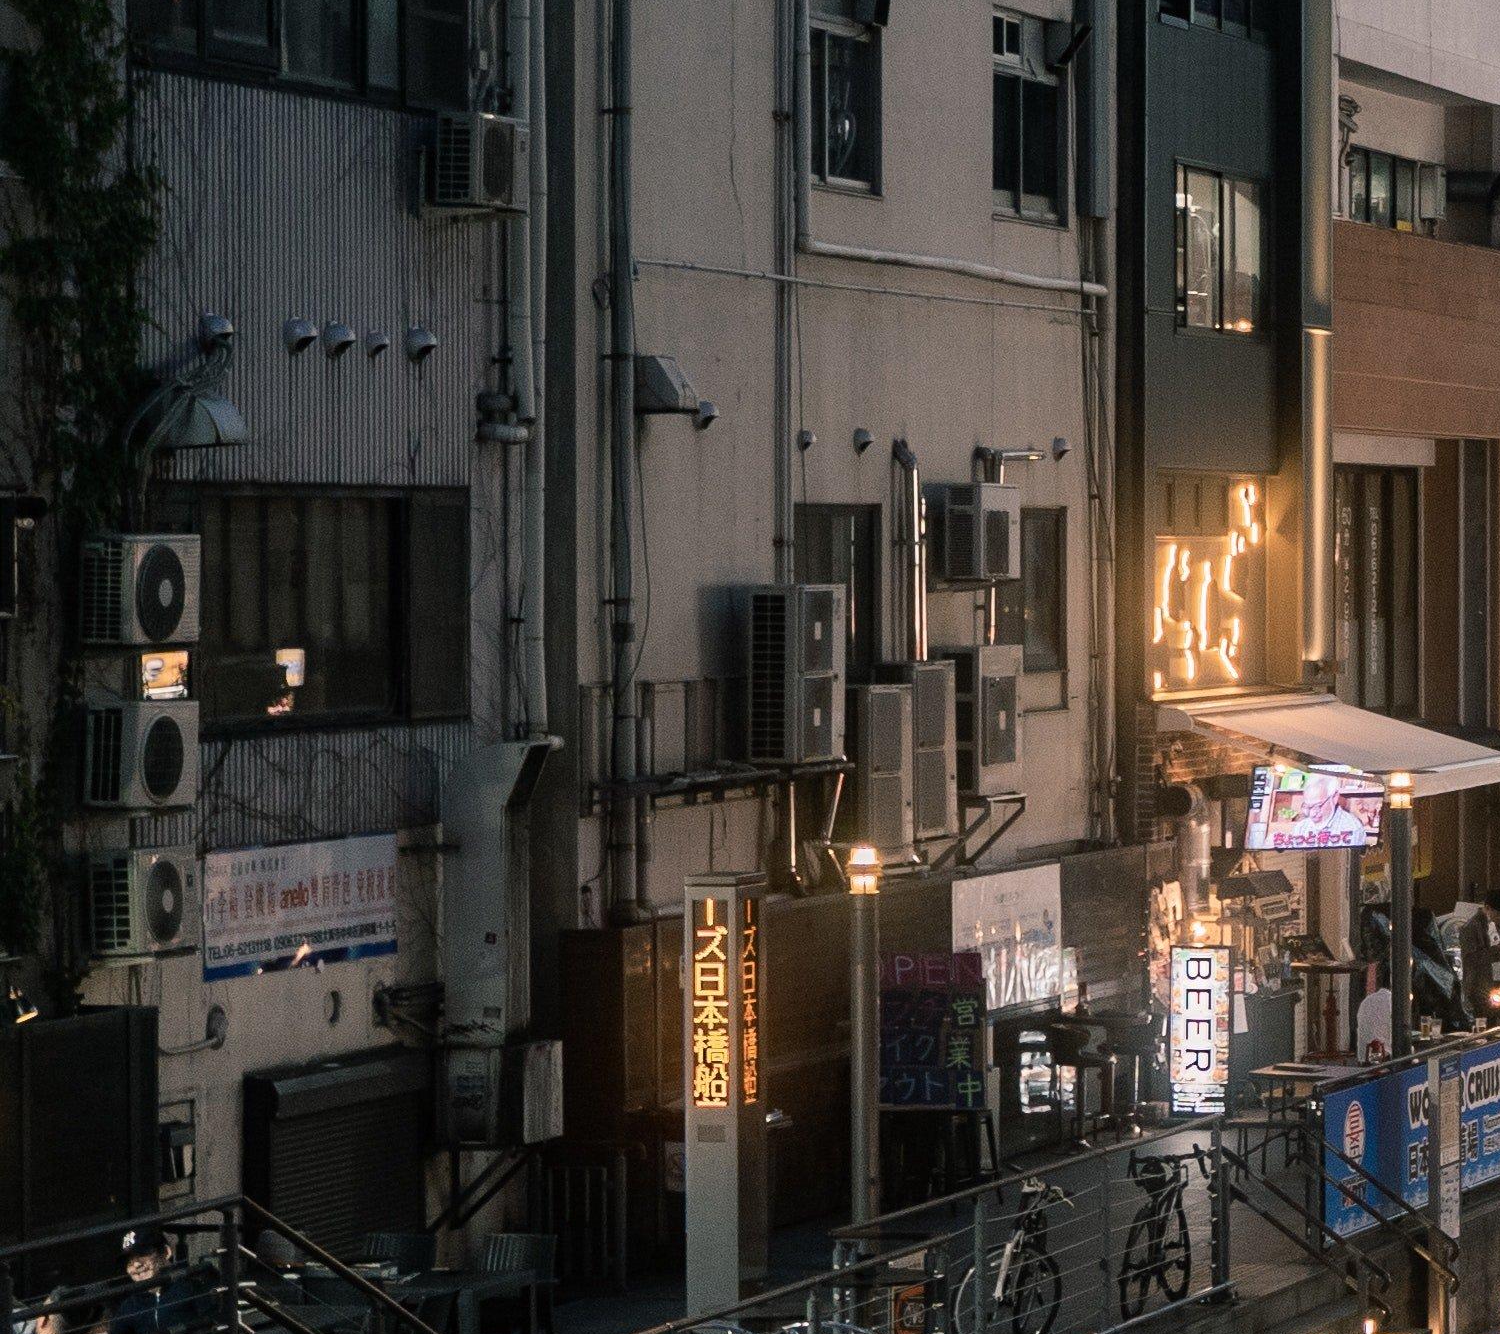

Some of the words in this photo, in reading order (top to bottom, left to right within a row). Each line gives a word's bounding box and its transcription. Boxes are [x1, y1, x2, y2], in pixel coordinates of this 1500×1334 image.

[693, 898, 729, 1107] ーズ日本橋船
[742, 898, 758, 1105] ーズ日本橋船
[880, 954, 980, 986] PEN
[1185, 957, 1212, 1072] BEER
[946, 997, 982, 1108] 営業中
